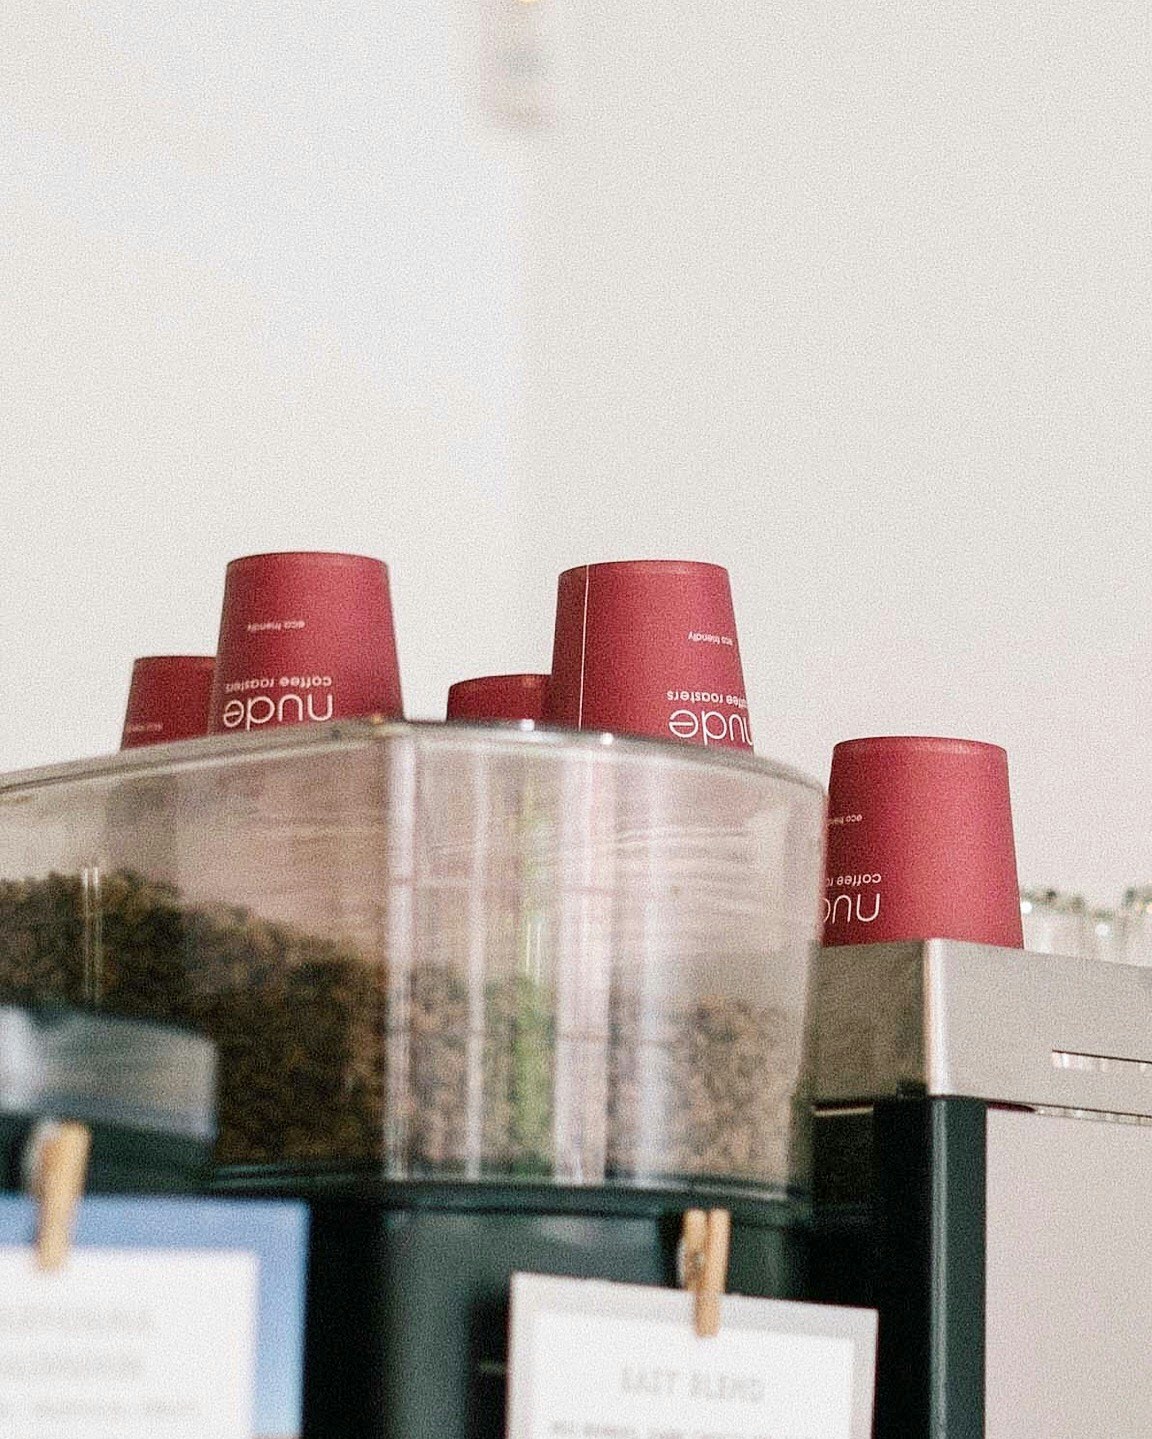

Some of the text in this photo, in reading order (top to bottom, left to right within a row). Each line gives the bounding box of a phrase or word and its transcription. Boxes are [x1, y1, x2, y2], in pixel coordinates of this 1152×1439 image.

[225, 676, 332, 693] coffee roasters
[666, 690, 723, 704] roasters
[223, 693, 334, 731] nude
[837, 873, 882, 887] coffee
[823, 893, 880, 924] nu
